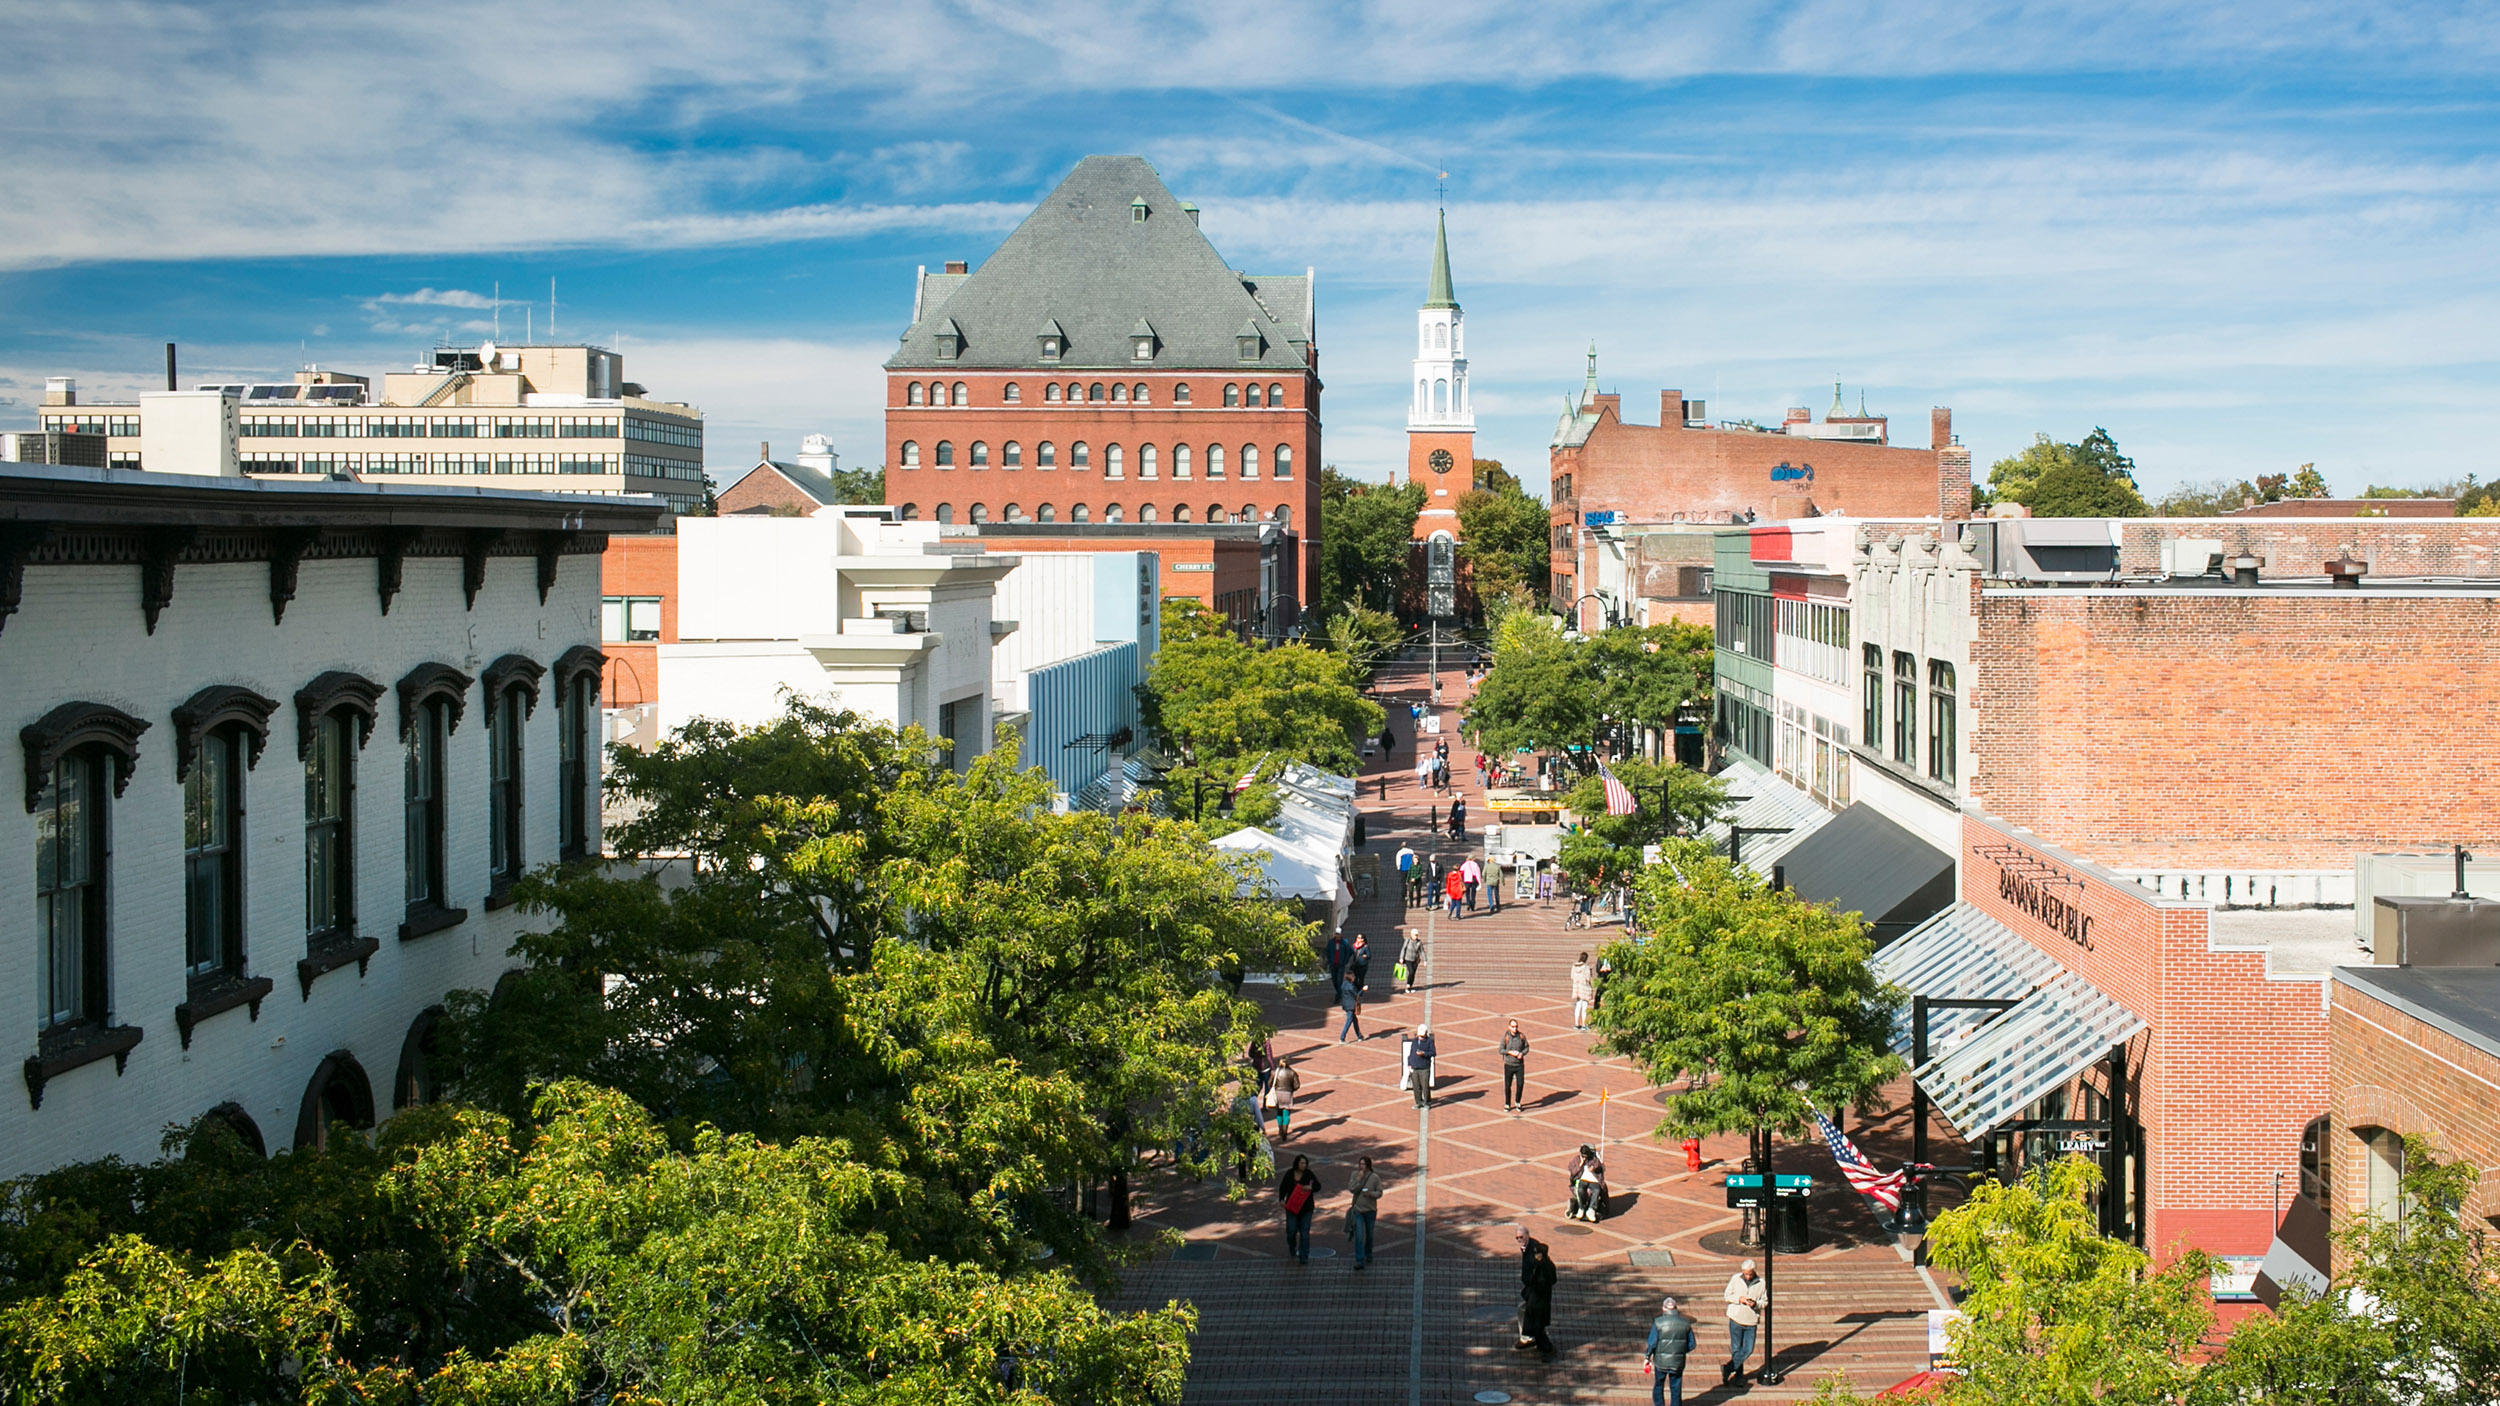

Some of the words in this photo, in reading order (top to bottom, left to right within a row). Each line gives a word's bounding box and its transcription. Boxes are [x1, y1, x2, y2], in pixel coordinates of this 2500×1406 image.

[226, 405, 238, 466] JAWS
[1175, 563, 1202, 571] CHERRY
[2000, 868, 2041, 920] BANANA
[2042, 891, 2095, 952] REPUBLIC
[2060, 1141, 2094, 1151] LEAHY
